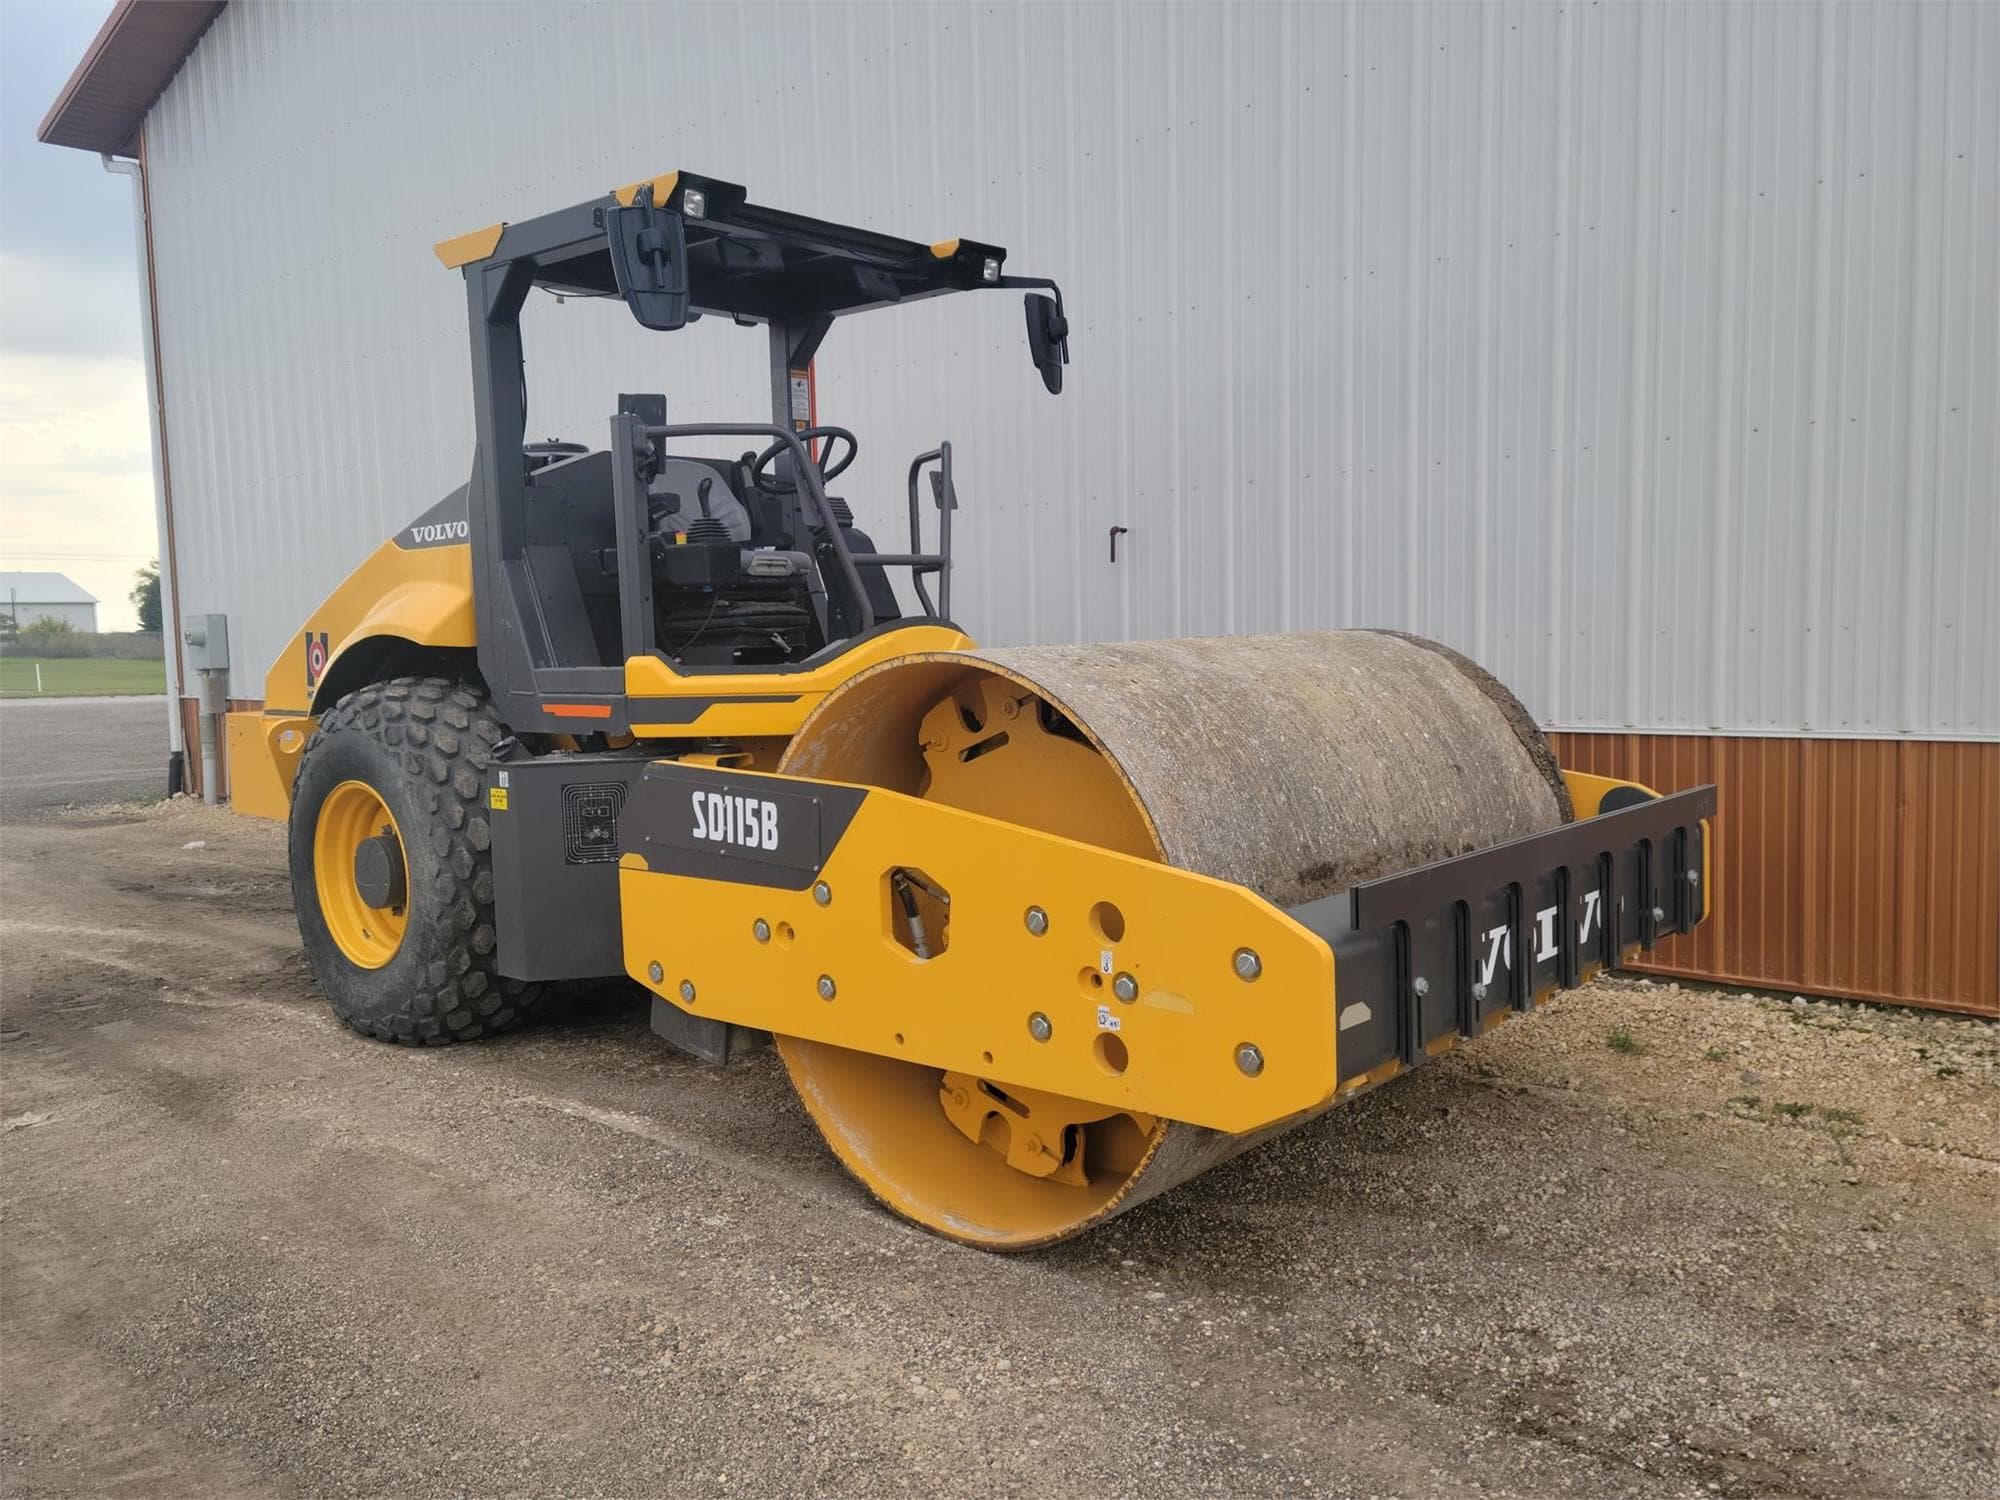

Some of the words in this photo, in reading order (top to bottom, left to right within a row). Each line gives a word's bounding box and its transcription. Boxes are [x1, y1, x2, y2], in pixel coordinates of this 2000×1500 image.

[410, 520, 469, 544] VOLVO
[692, 791, 779, 851] SD115B
[1481, 889, 1625, 986] VLV
